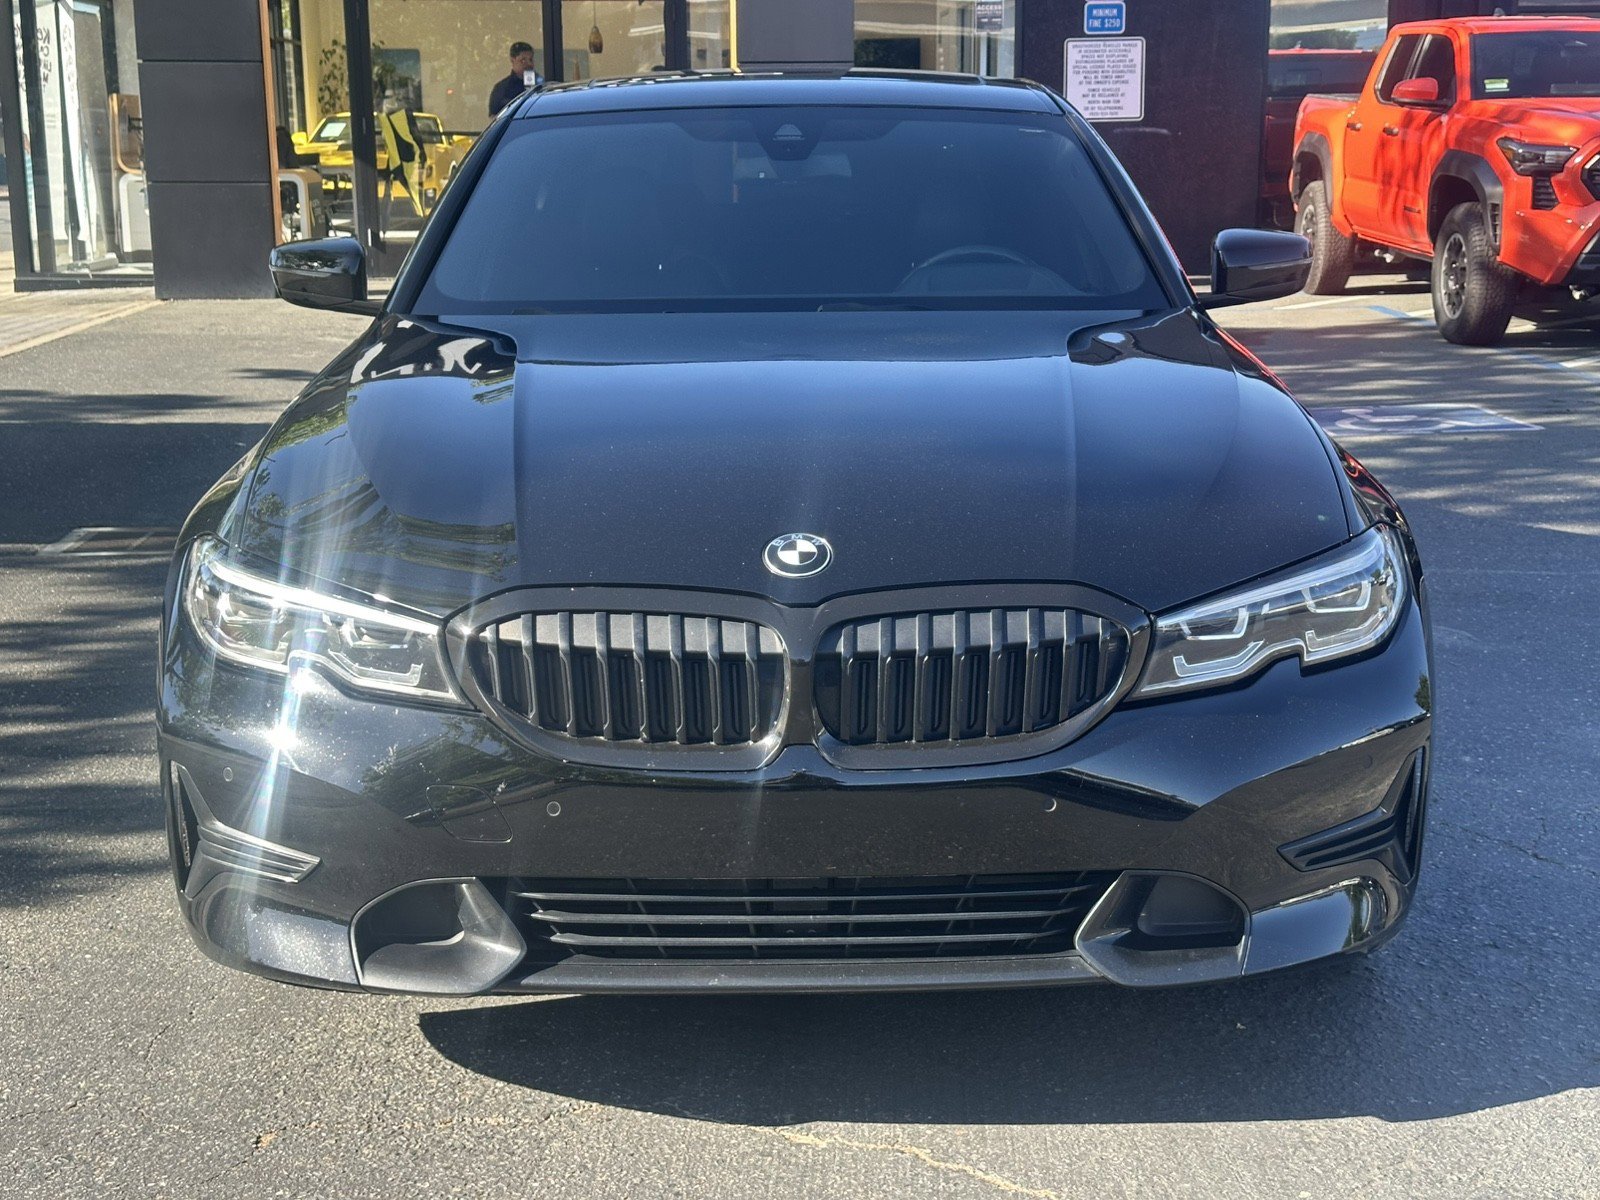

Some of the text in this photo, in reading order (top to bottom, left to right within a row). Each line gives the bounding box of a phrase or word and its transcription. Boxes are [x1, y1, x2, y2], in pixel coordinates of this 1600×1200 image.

[1092, 8, 1117, 17] MINIMUM
[1089, 18, 1121, 28] FINE $250
[771, 533, 823, 547] BMW
